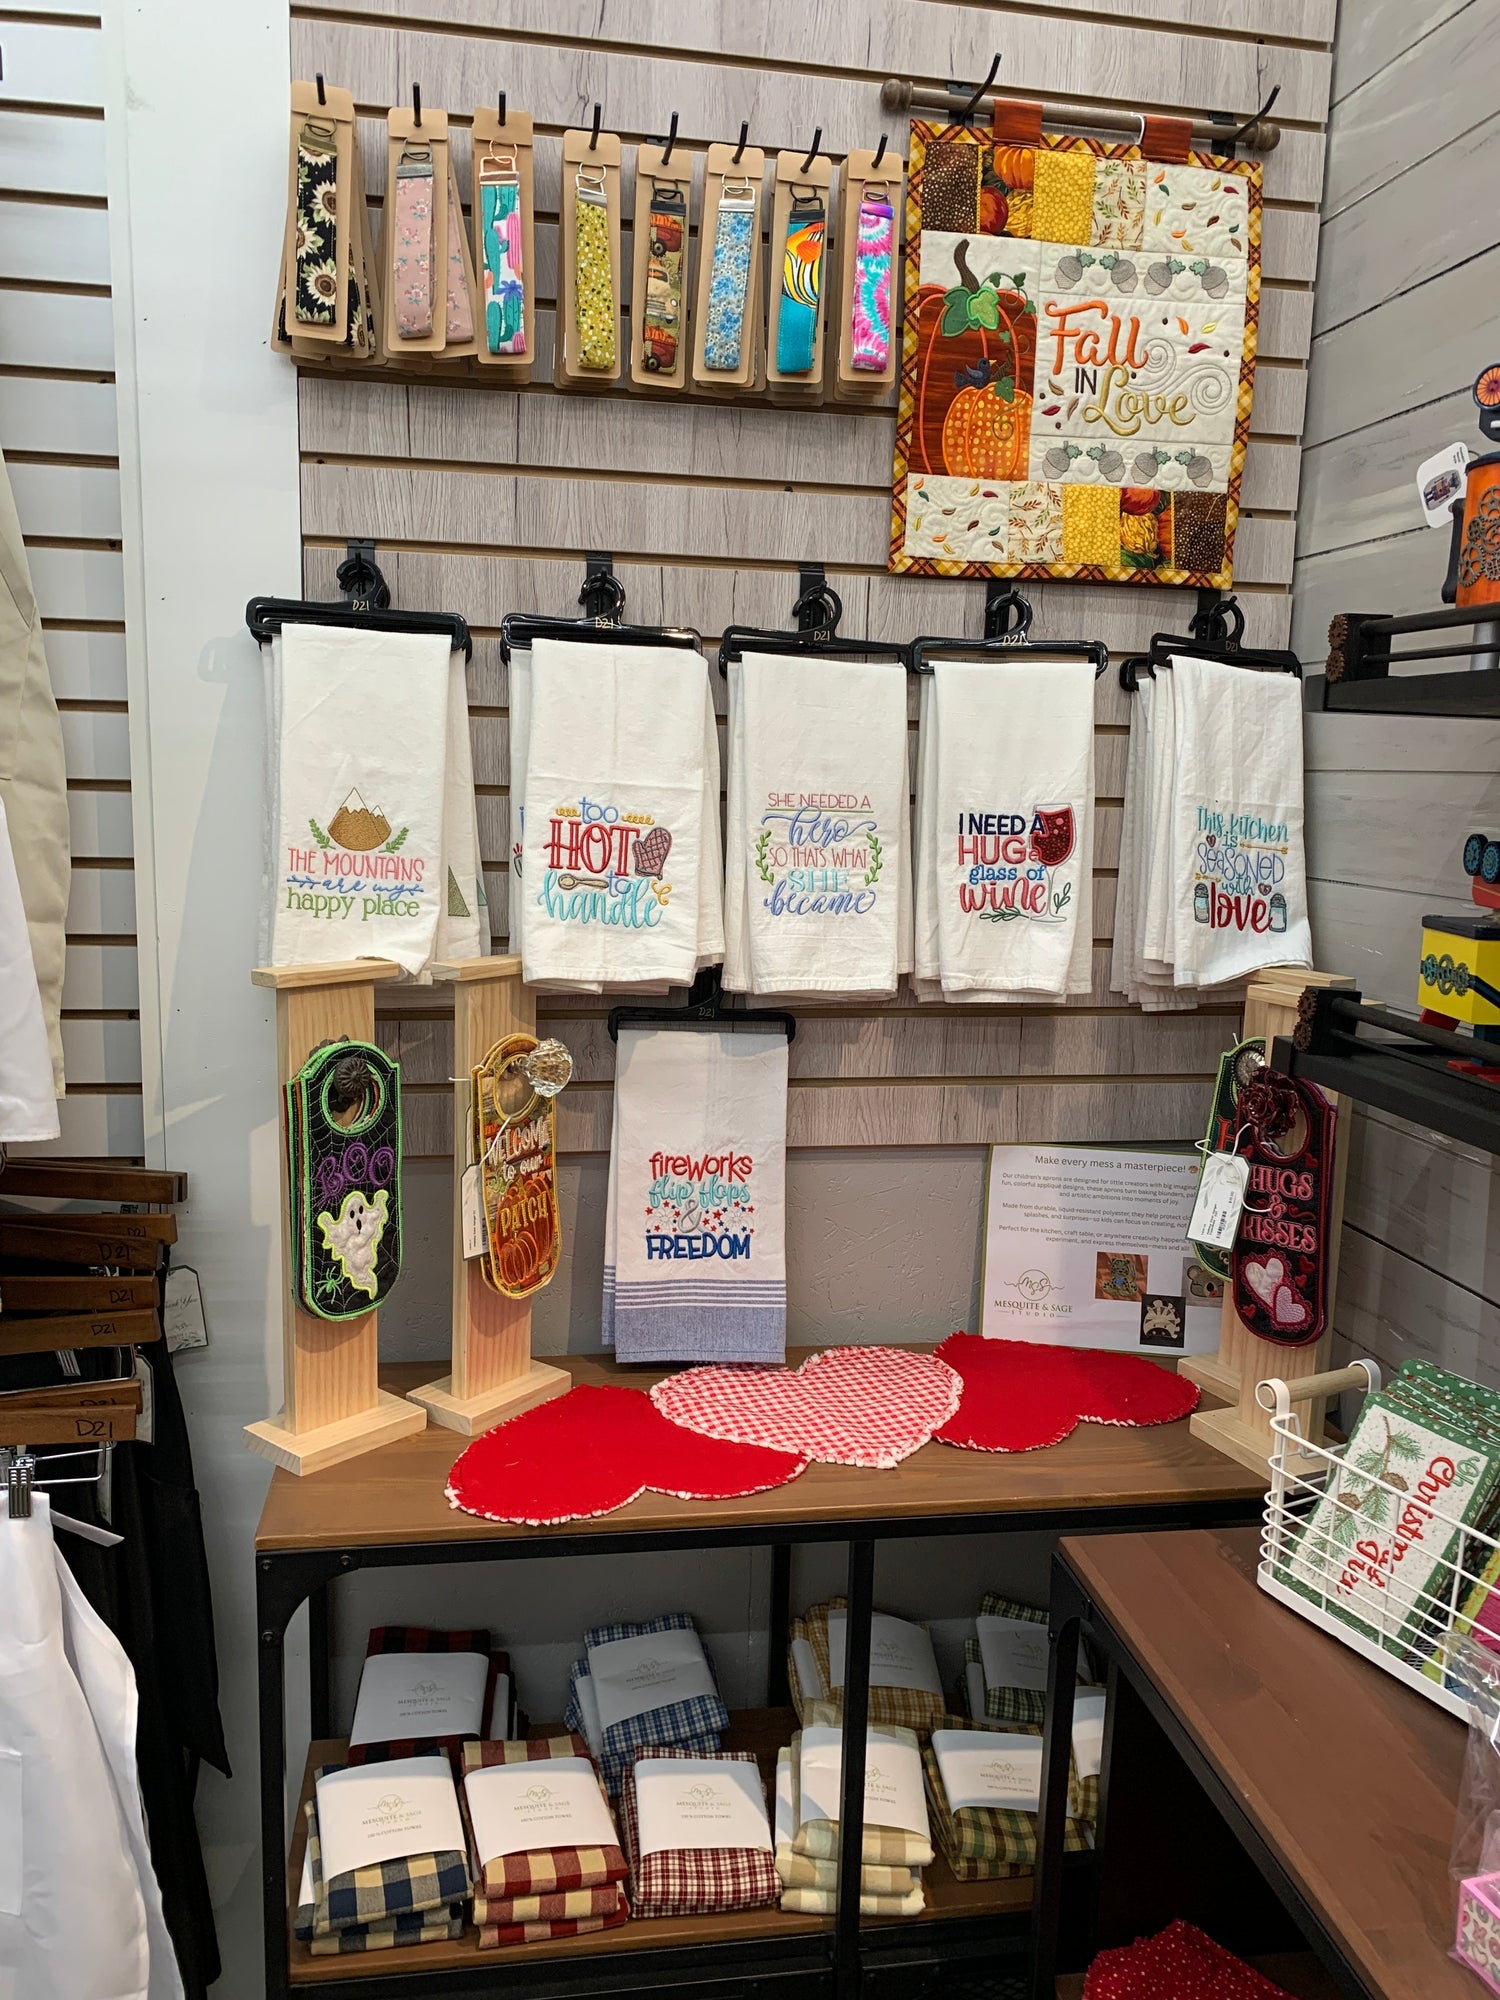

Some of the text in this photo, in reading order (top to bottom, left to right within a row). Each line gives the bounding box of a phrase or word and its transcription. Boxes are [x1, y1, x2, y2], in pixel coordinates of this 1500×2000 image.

[1044, 300, 1148, 375] Fall
[1075, 365, 1197, 437] IN Love
[813, 630, 830, 642] D21
[579, 796, 618, 824] too
[768, 792, 872, 809] SHE NEEDED A
[761, 805, 877, 848] hero
[959, 813, 1046, 836] I NEED A
[1197, 805, 1289, 844] This kitchen
[543, 818, 641, 876] HOT
[1222, 831, 1238, 848] is
[288, 847, 425, 882] THE MOUNTAINS
[770, 846, 868, 868] SO THAT'S WHAT
[606, 870, 632, 898] to
[788, 868, 850, 893] SHE
[969, 864, 1047, 885] glass of
[1221, 873, 1255, 896] with
[286, 886, 420, 922] happy place
[322, 878, 408, 902] are my
[537, 869, 664, 929] handle
[763, 879, 876, 916] became
[960, 876, 1046, 914] wine
[1210, 881, 1273, 934] love
[486, 1116, 552, 1166] WELCOME
[311, 1142, 394, 1207] BOO
[501, 1154, 544, 1182] to our
[648, 1151, 753, 1182] fireworks
[1035, 1155, 1060, 1165] Make
[1062, 1158, 1088, 1168] every
[1090, 1160, 1114, 1169] mess
[1124, 1162, 1186, 1174] masterpiece!
[648, 1174, 750, 1208] flip flops
[1074, 1176, 1100, 1184] designed
[1163, 1182, 1172, 1190] big
[1250, 1163, 1314, 1200] HUGS
[500, 1190, 549, 1238] PATCH
[678, 1199, 706, 1234] &
[1101, 1216, 1112, 1224] kids
[1146, 1212, 1159, 1220] help
[1269, 1193, 1288, 1220] &
[646, 1232, 751, 1260] FREEDOM
[999, 1224, 1020, 1232] Perfect
[1132, 1234, 1160, 1242] creativity
[1092, 1240, 1115, 1248] express
[1241, 1214, 1318, 1254] KISSES
[108, 1289, 135, 1304] D21
[994, 1300, 1040, 1310] MESQUITE
[1050, 1304, 1073, 1313] SAGE
[1011, 1310, 1055, 1318] STUDIO
[91, 1323, 117, 1336] D21
[75, 1419, 113, 1439] D21
[1450, 1456, 1481, 1488] Oh
[1366, 1456, 1456, 1588] Christmas
